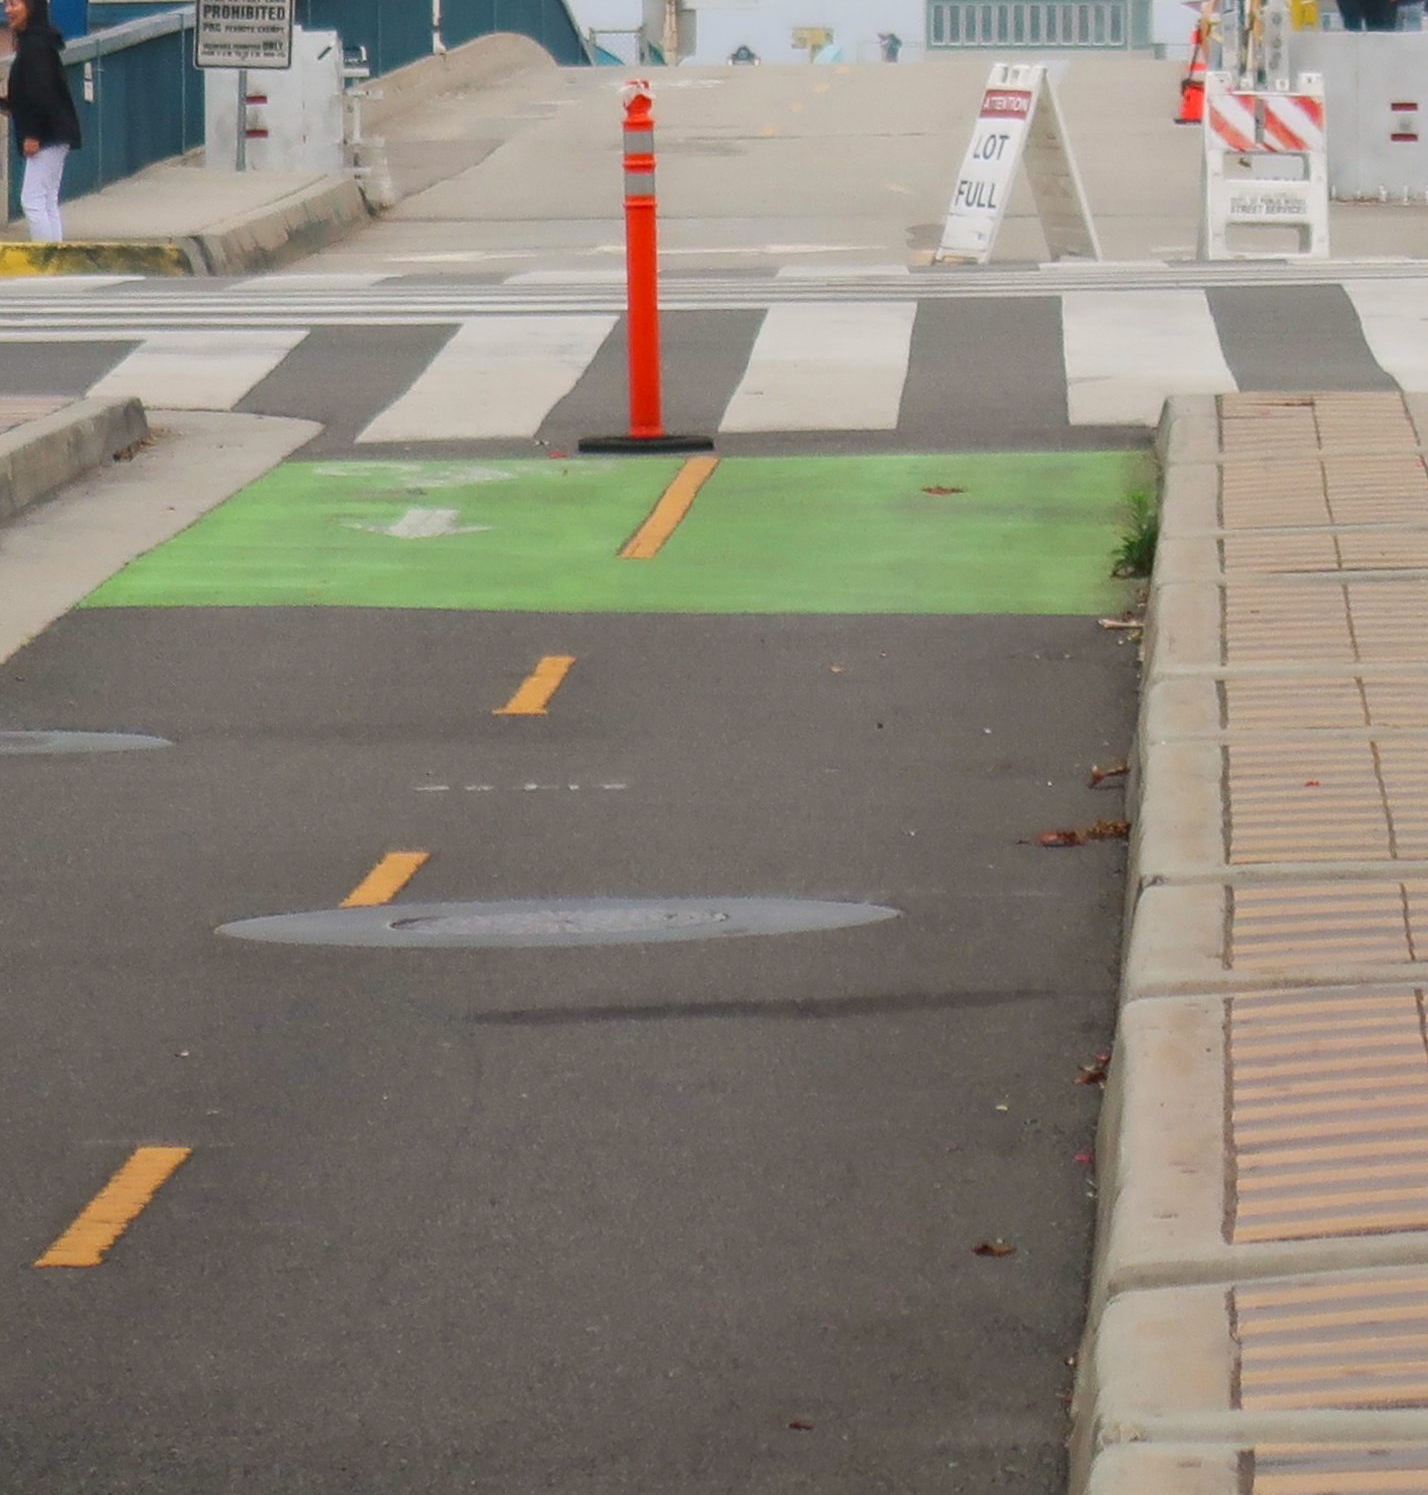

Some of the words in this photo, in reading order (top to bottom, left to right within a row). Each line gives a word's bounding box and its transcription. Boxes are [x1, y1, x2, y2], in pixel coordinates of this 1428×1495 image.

[203, 4, 286, 21] PROHIBITED
[983, 96, 1029, 111] ATTENTION
[973, 134, 1010, 161] LOT
[955, 180, 997, 209] FULL
